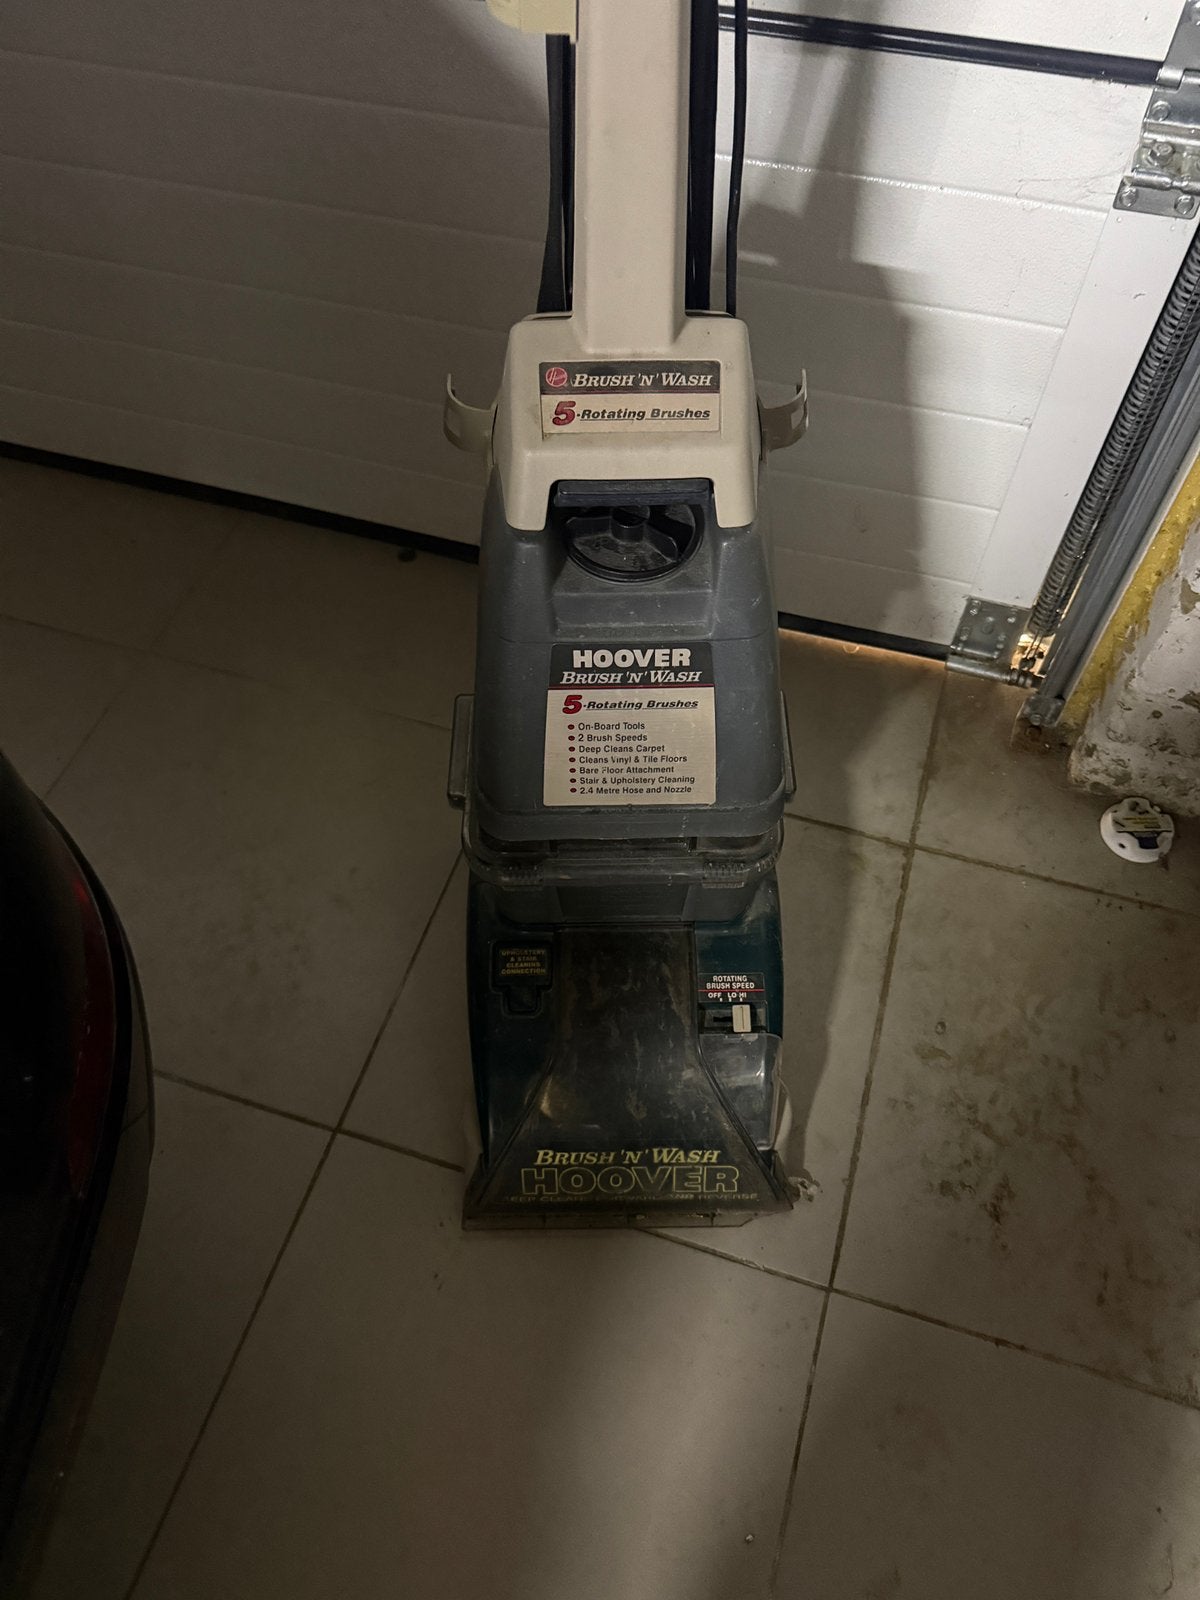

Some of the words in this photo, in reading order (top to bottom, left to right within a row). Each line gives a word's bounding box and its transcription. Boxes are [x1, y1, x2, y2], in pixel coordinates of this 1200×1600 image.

[573, 373, 635, 387] BRUSH
[661, 372, 713, 387] WASH
[650, 408, 710, 419] Brushes
[573, 648, 692, 668] HOOVER
[560, 671, 624, 684] BRUSH
[650, 670, 703, 683] WASH
[647, 700, 699, 709] Brushes
[578, 722, 620, 731] On-Board
[623, 722, 645, 730] Tools
[578, 734, 584, 742] 2
[587, 734, 613, 742] Brush
[615, 733, 648, 743] Speeds
[578, 745, 601, 754] Deep
[604, 745, 634, 753] Cleans
[636, 745, 665, 754] Carpet
[579, 756, 609, 764] Cleans
[611, 756, 632, 765] Vinyl
[643, 755, 658, 763] Tile
[660, 755, 688, 763] Floors
[626, 766, 674, 774] Attachment
[610, 776, 656, 787] Upholstery
[658, 776, 696, 784] Cleaning
[622, 786, 644, 794] Hose
[533, 1149, 615, 1166] BRUSH
[651, 1148, 721, 1164] WASH
[521, 1166, 739, 1195] HOOVER
